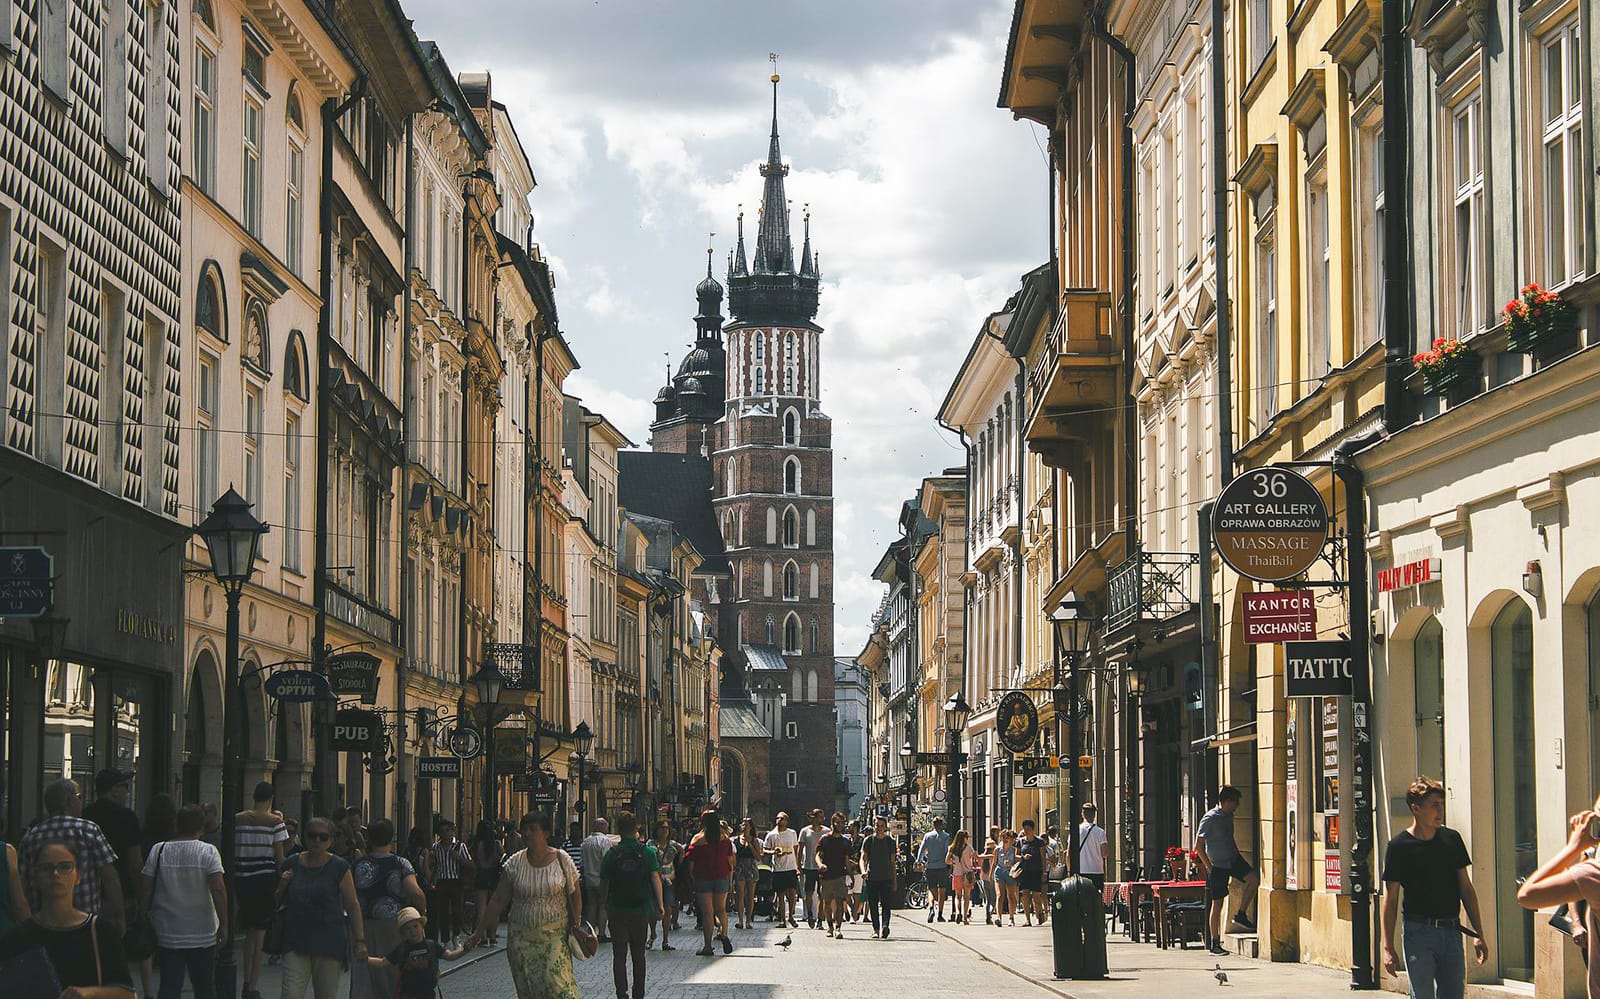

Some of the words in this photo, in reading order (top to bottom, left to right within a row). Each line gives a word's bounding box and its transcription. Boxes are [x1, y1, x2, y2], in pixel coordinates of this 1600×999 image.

[1252, 473, 1288, 498] 36
[1223, 503, 1252, 515] ART
[1255, 503, 1317, 515] GALLERY
[1220, 519, 1266, 528] OPRAWA
[1267, 516, 1321, 528] OBRAZÓW
[1231, 536, 1310, 550] MASSAGE
[1247, 555, 1294, 566] ThaiBali
[1247, 598, 1311, 611] KANTOR
[1249, 621, 1313, 635] EXCHANGE
[276, 685, 317, 696] OPTYK
[334, 726, 369, 741] PUB
[926, 754, 953, 763] HOTEL
[421, 762, 459, 772] HOSTEL
